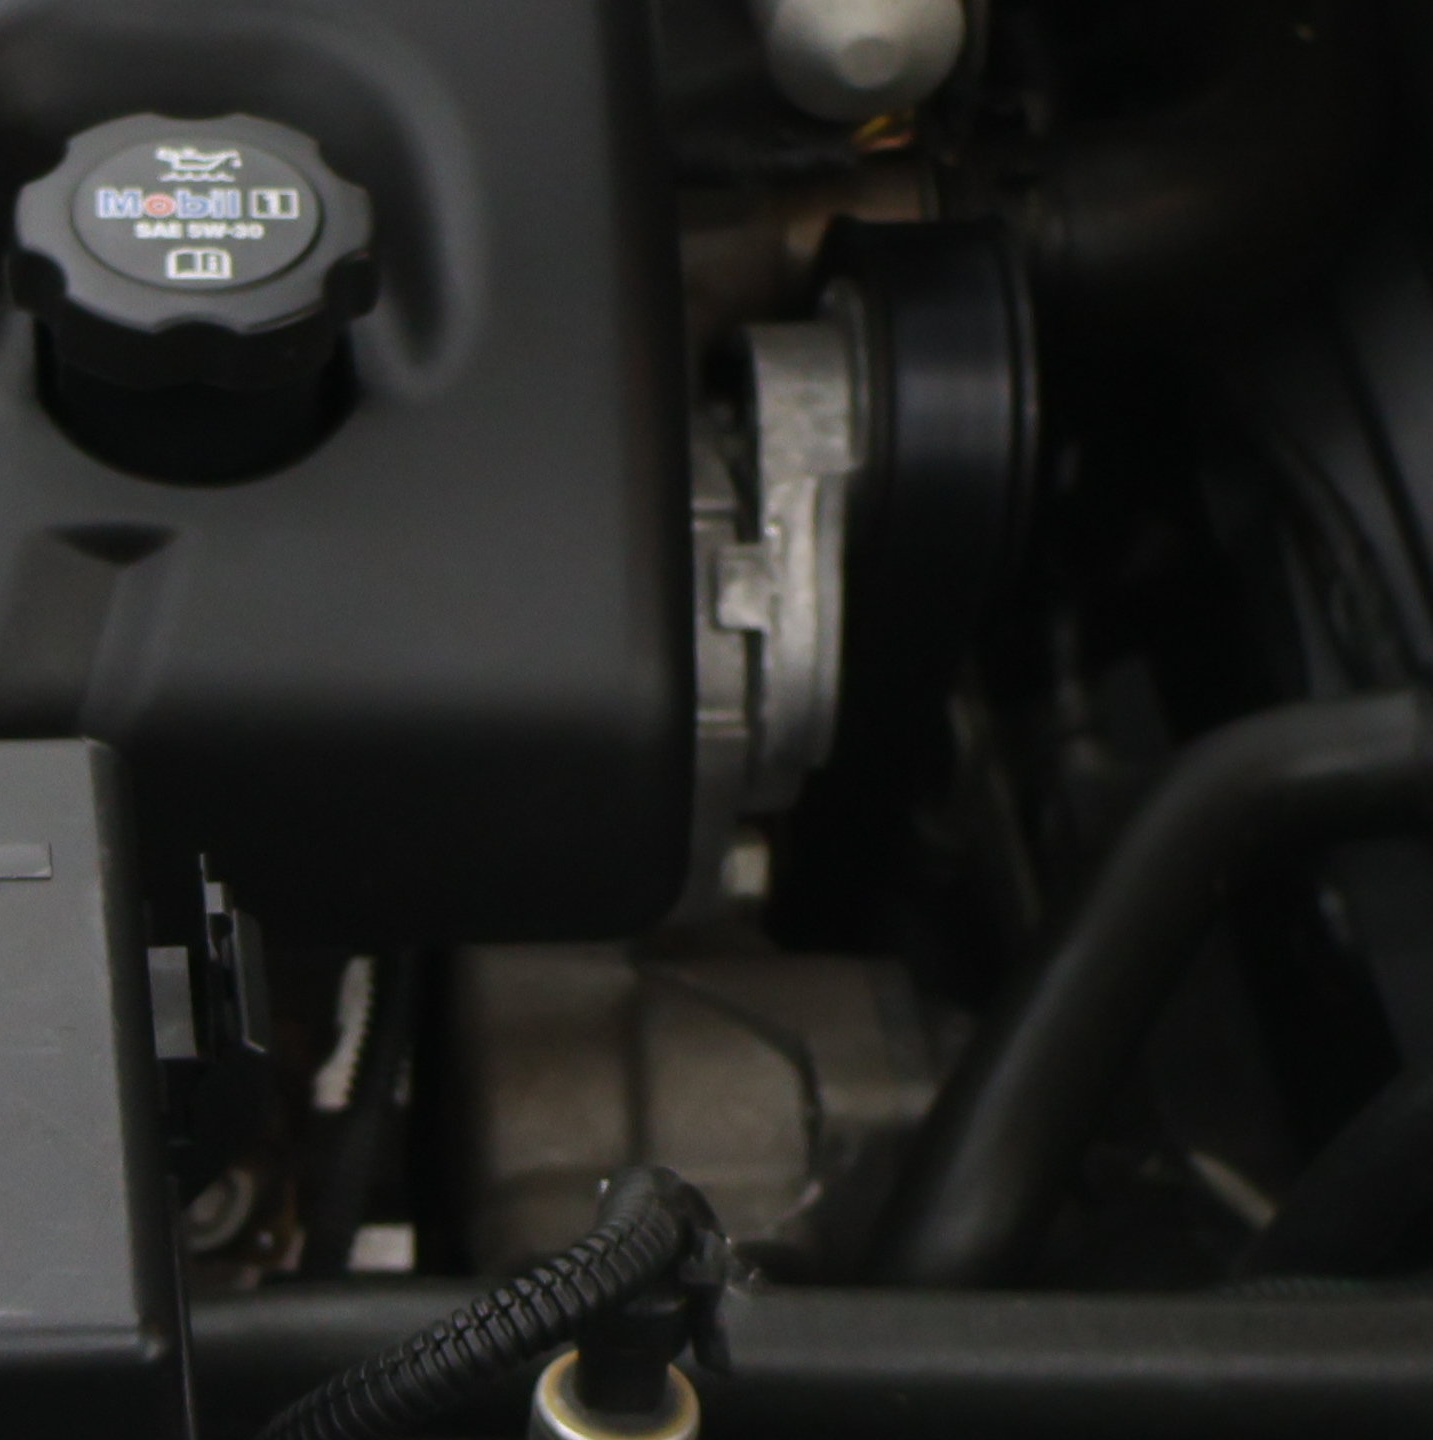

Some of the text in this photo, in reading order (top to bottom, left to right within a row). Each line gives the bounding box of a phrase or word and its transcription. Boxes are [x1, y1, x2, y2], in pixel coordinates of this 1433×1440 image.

[95, 187, 243, 219] Mobil
[133, 221, 266, 240] SAE 5W-30
